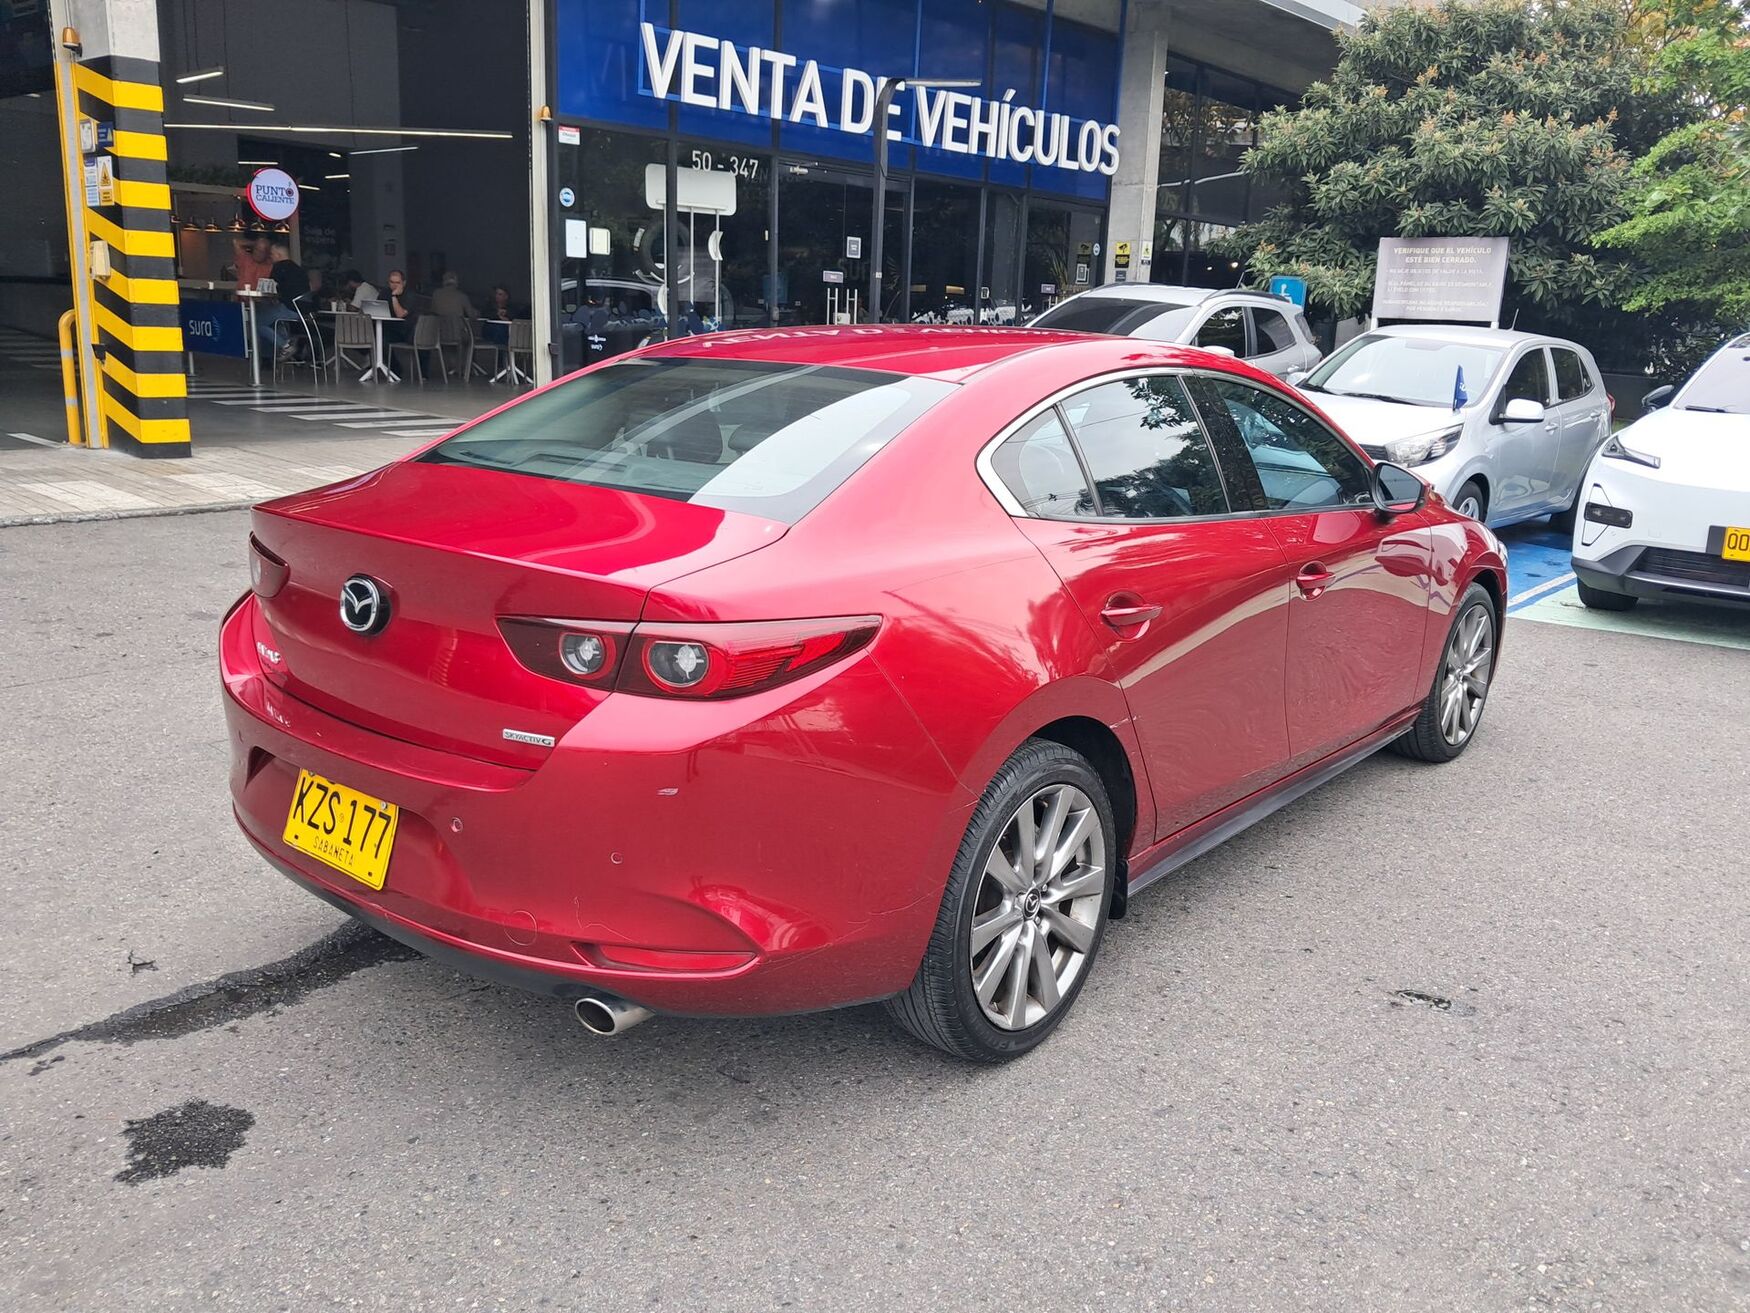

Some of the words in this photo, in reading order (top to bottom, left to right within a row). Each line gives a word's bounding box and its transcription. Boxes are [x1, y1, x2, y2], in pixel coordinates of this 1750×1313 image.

[641, 22, 828, 128] VENTA
[916, 88, 1120, 176] VEHÍCULOS
[692, 150, 712, 172] 50
[730, 156, 758, 179] 347
[256, 184, 294, 197] PUNTO
[256, 194, 294, 204] CALIENTE
[189, 320, 212, 336] sura
[293, 776, 341, 835] KZS
[343, 800, 391, 859] 177
[313, 836, 354, 866] SABANETA
